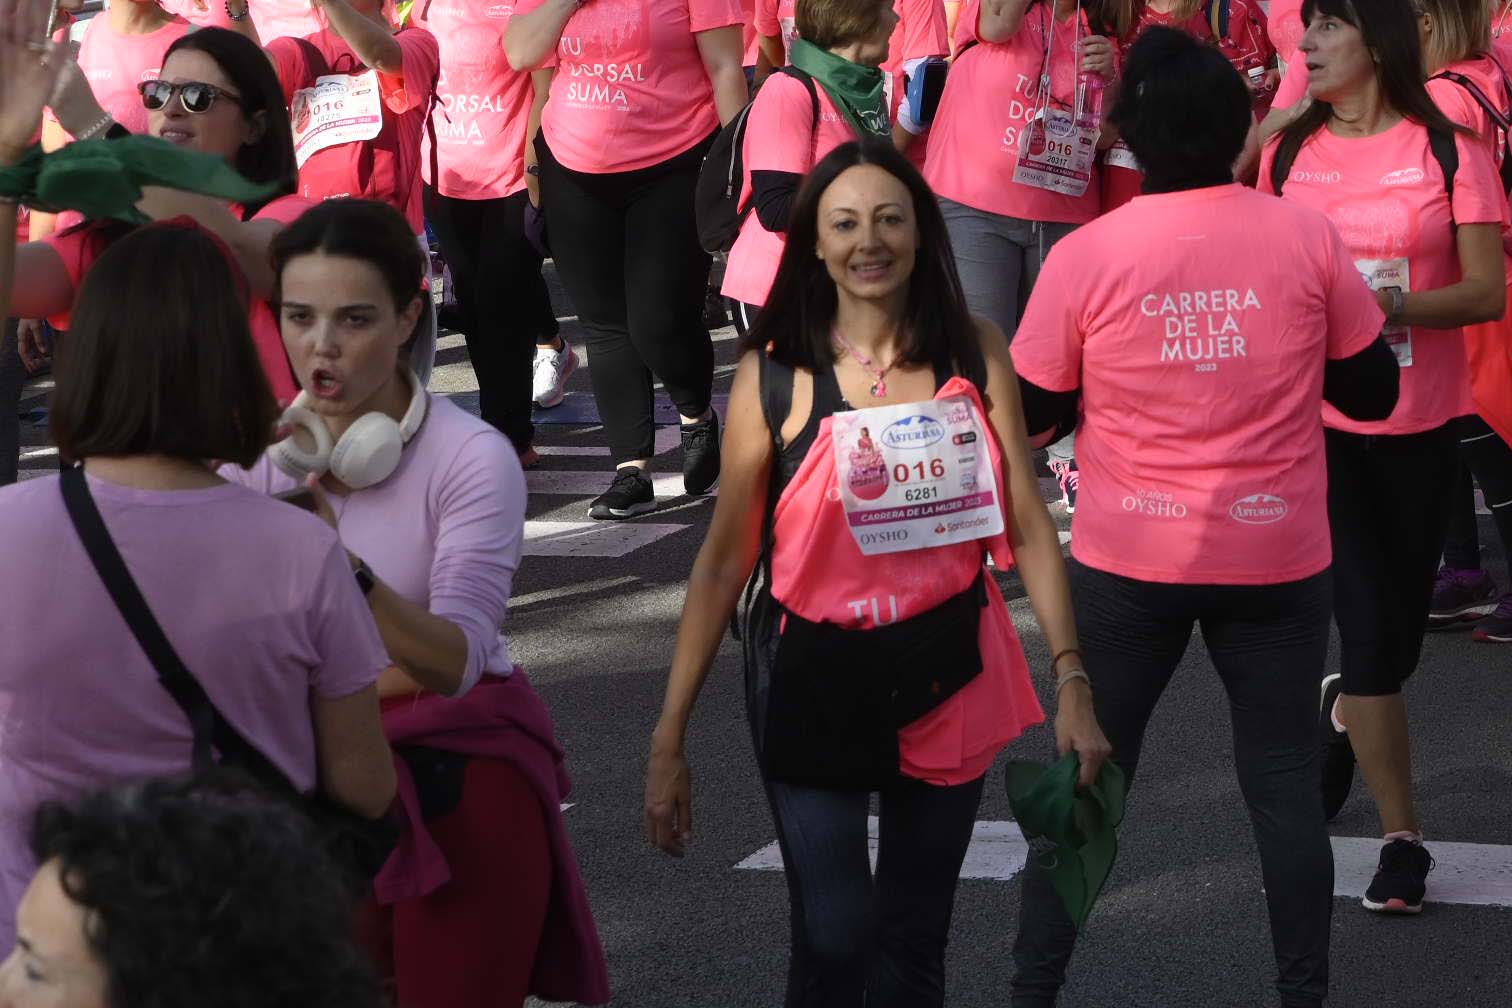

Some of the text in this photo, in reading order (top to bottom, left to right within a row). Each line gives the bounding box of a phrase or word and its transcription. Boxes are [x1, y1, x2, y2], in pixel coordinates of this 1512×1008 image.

[566, 82, 628, 105] SUMA
[313, 99, 344, 115] 016
[1047, 140, 1073, 156] 016
[1293, 170, 1341, 184] OYSHO
[1140, 287, 1262, 317] CARRERA
[1164, 311, 1241, 339] DE LA
[1160, 335, 1248, 363] MUJER
[893, 458, 945, 483] 016
[905, 486, 939, 502] 6281
[860, 509, 905, 523] CARRERA
[906, 507, 920, 517] DE
[921, 505, 934, 515] LA
[935, 500, 963, 513] MUJER
[1121, 495, 1188, 519] OYSHO
[859, 528, 909, 546] OYSHO
[847, 594, 898, 626] TU
